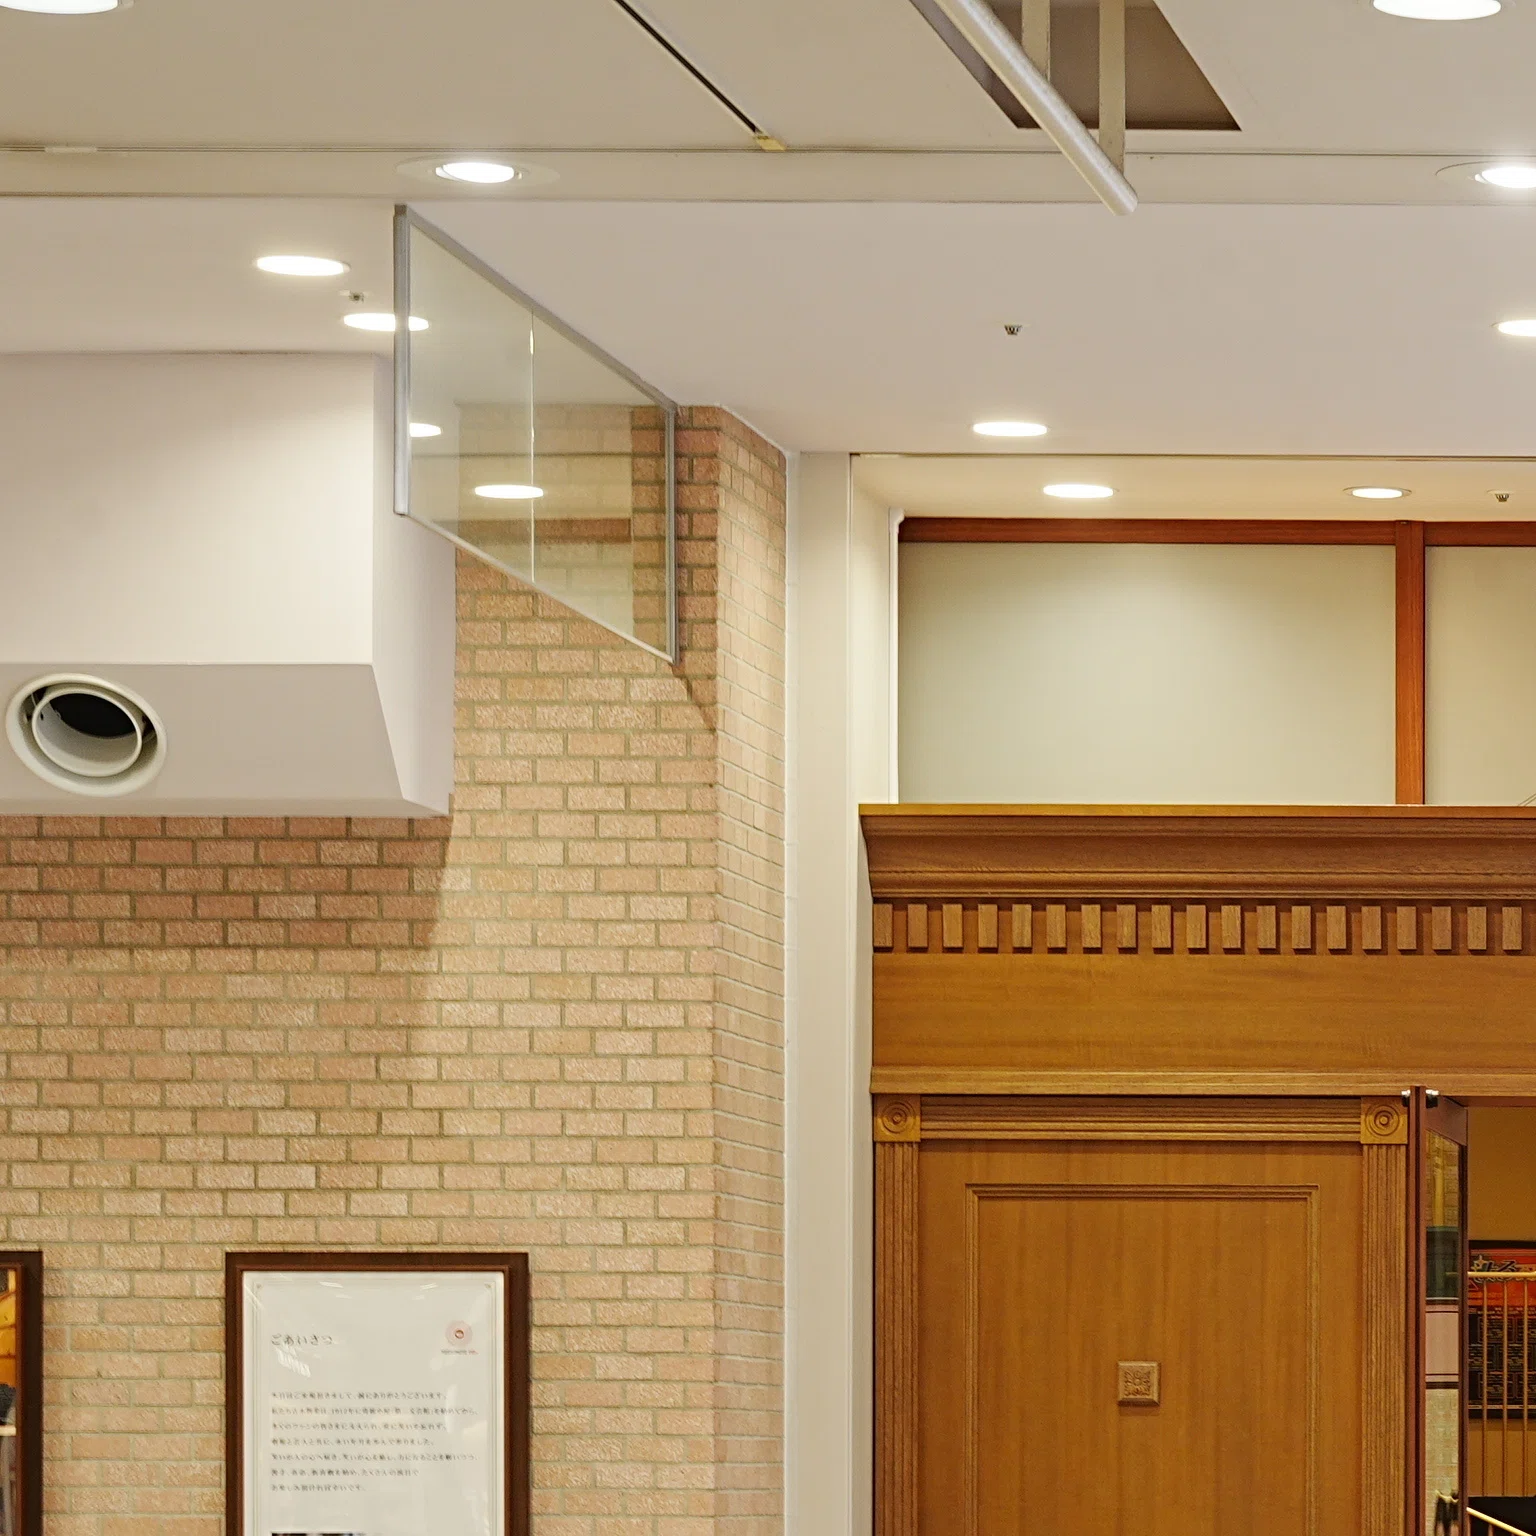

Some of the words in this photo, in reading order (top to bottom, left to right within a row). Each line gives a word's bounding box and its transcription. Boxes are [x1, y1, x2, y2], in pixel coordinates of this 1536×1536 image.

[271, 1334, 334, 1346] ごあいさつ
